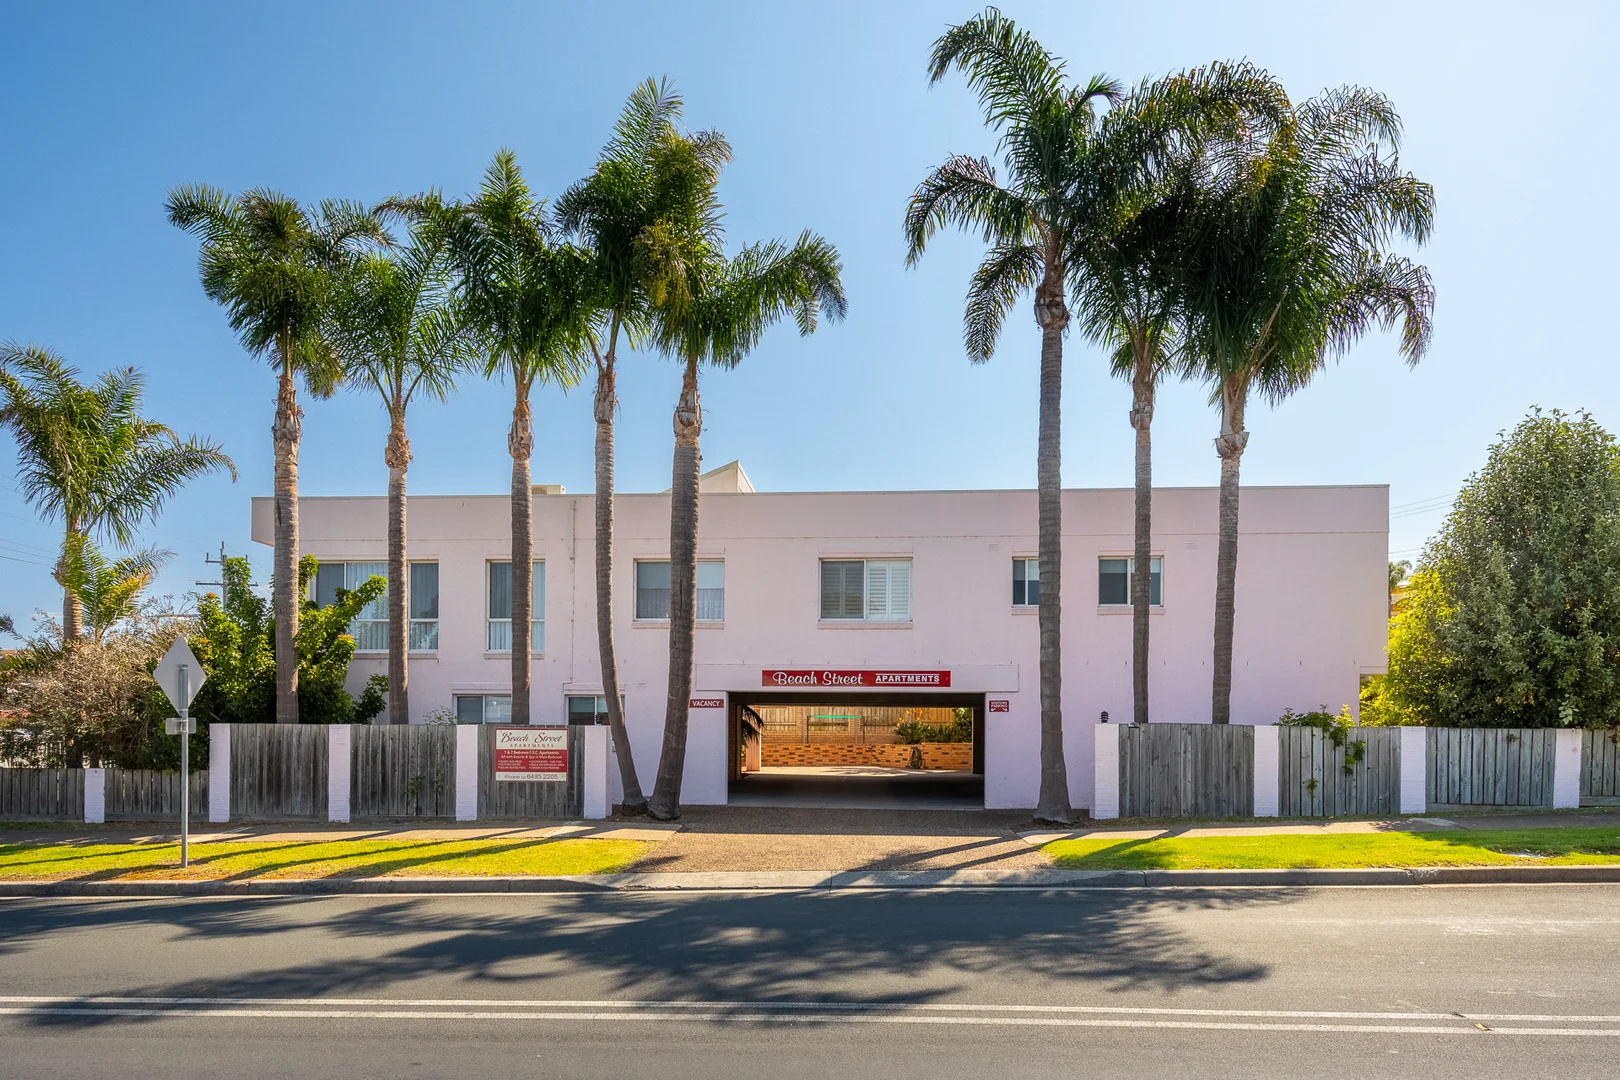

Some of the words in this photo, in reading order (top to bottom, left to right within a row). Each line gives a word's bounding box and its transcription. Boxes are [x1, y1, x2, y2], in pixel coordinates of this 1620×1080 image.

[772, 671, 818, 686] Beach
[822, 671, 863, 686] Street
[876, 675, 940, 683] APARTMENTS
[501, 732, 529, 743] Beach
[534, 732, 562, 743] Street
